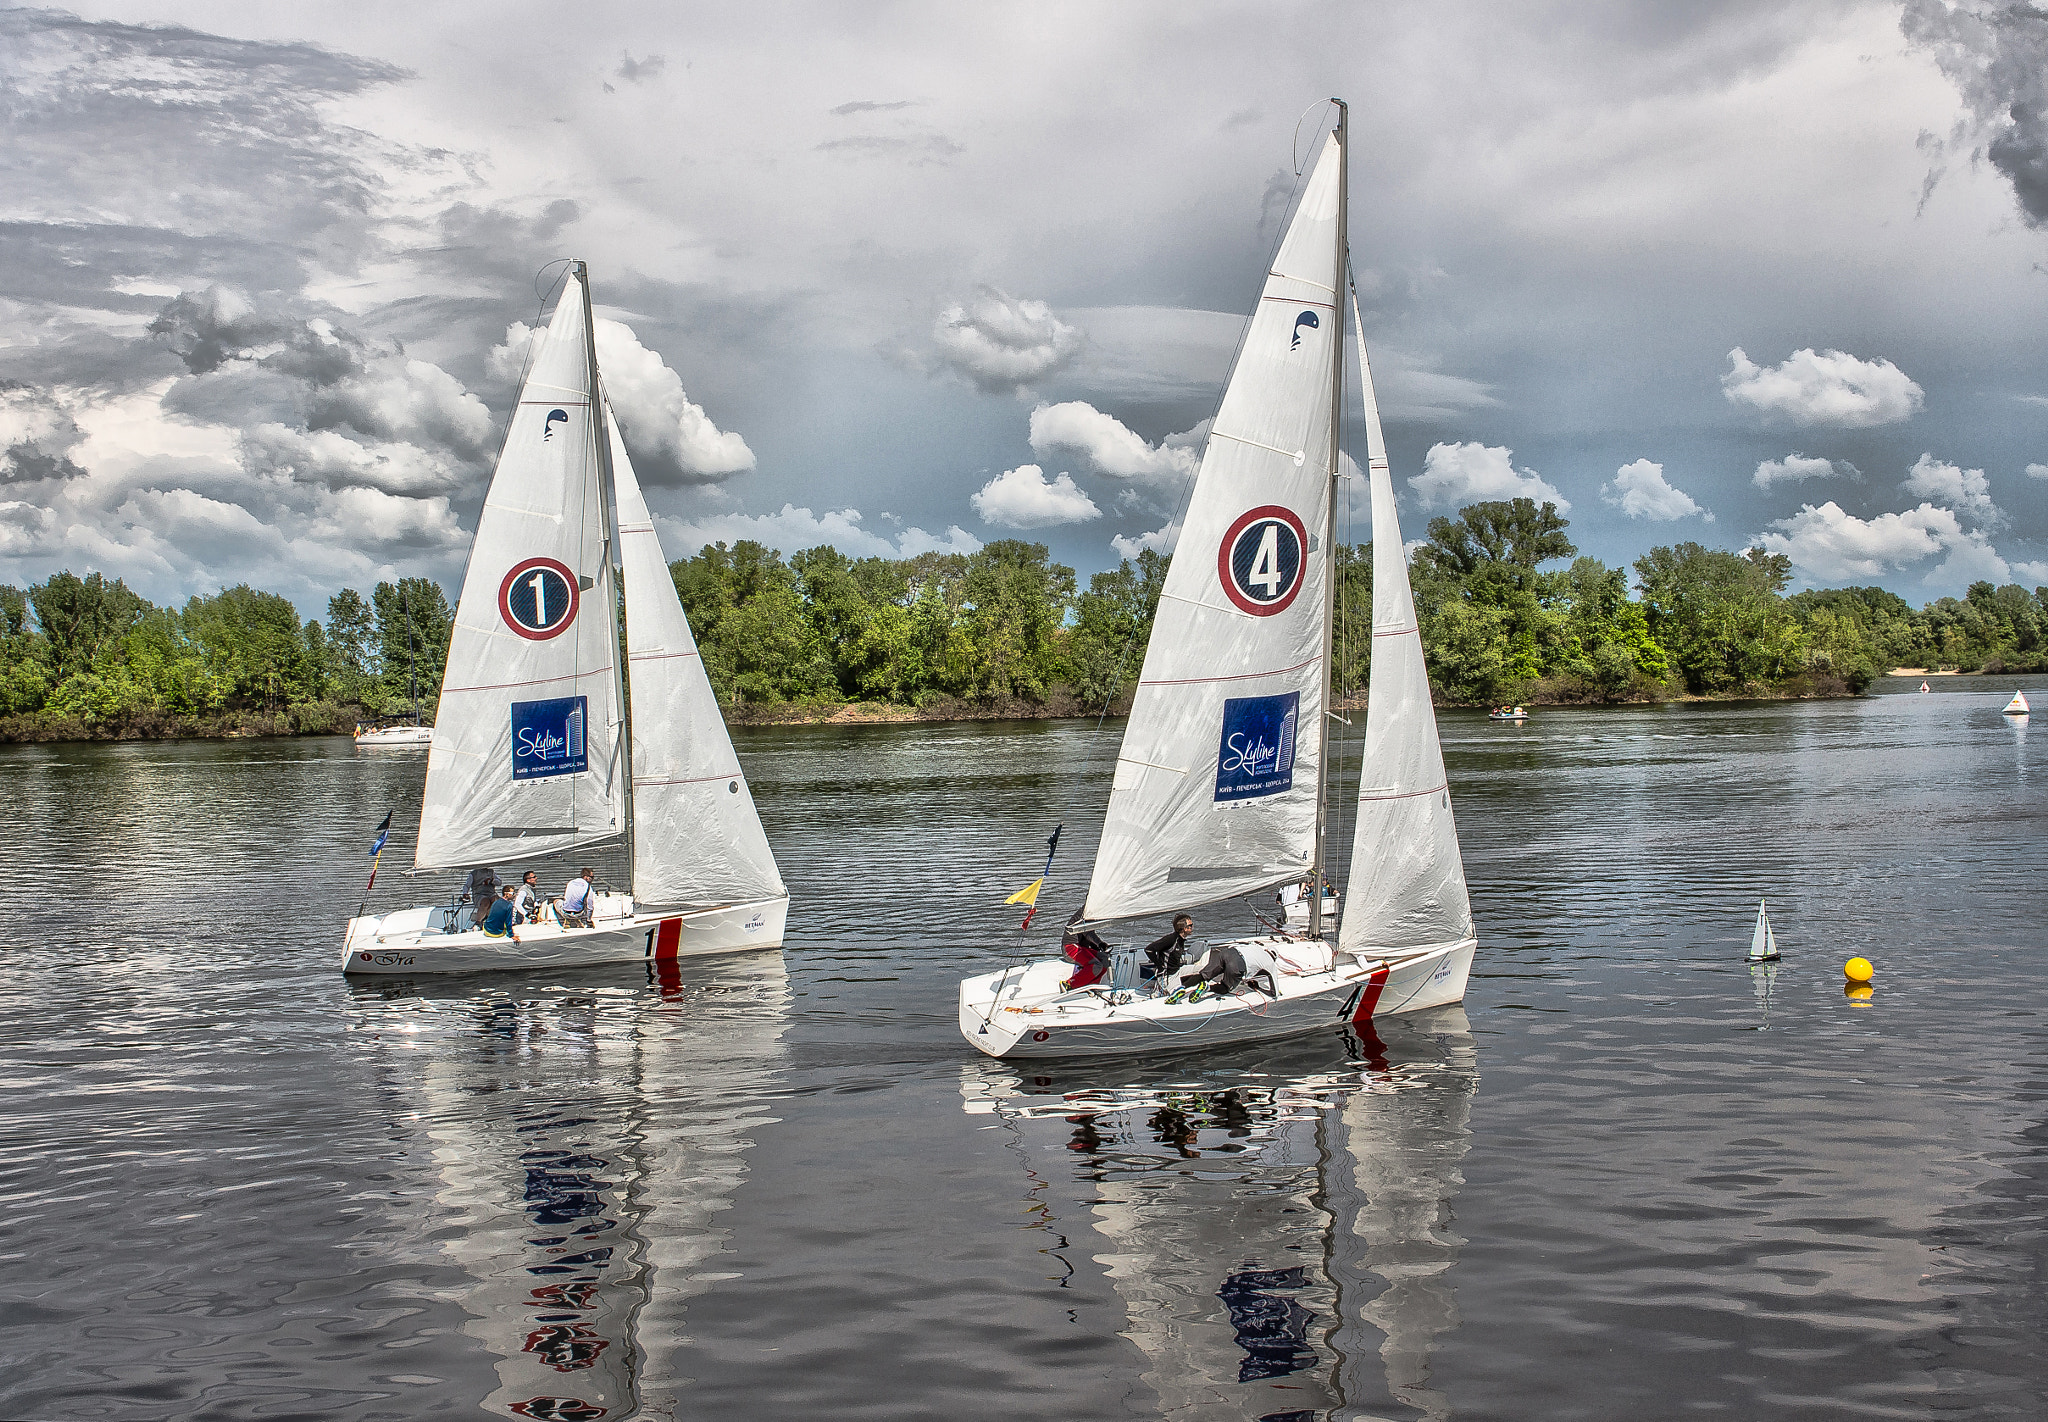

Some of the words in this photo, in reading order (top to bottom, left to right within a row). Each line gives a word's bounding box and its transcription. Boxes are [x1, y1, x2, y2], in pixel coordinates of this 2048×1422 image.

[1249, 525, 1281, 597] 4
[528, 573, 547, 625] 1
[516, 727, 564, 760] Skyline
[1223, 732, 1275, 777] Skyline
[644, 928, 656, 957] 1
[1336, 985, 1363, 1022] 4
